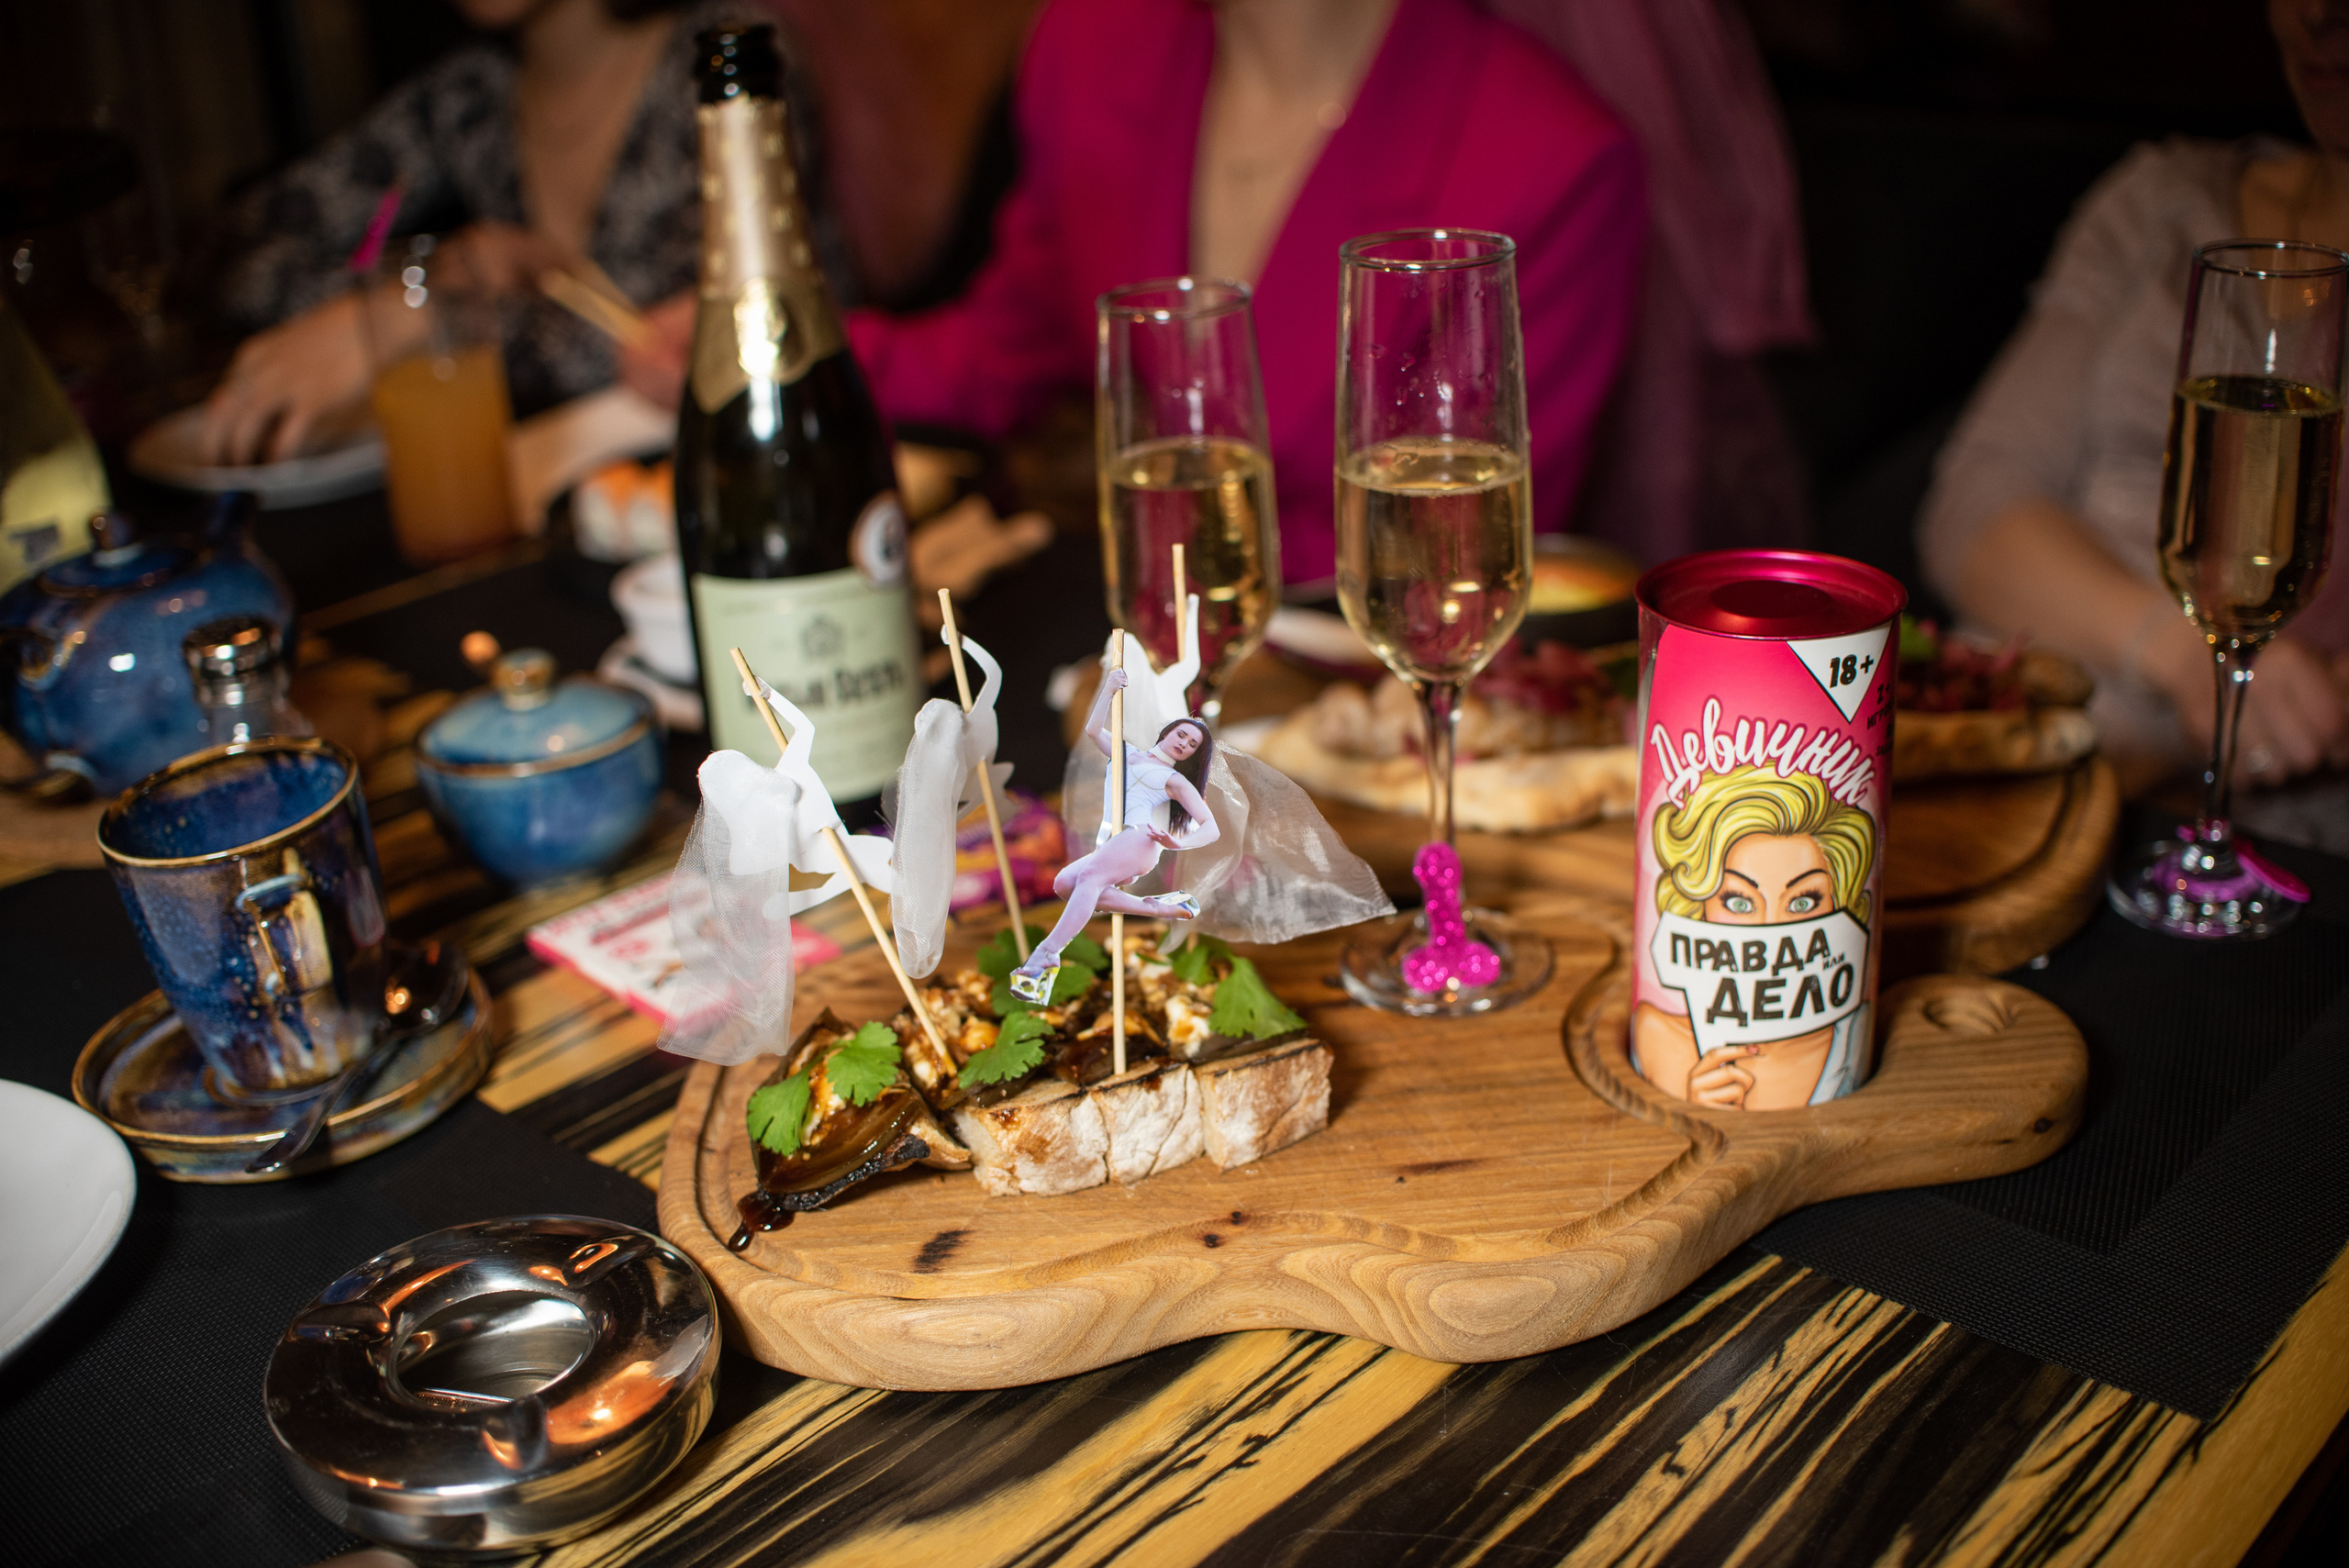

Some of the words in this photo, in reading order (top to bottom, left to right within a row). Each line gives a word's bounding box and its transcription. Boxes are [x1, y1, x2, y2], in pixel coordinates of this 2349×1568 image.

[1829, 654, 1875, 688] 18+
[1651, 697, 1875, 810] Девичник
[1670, 928, 1831, 976] ПРАВДА
[1705, 962, 1854, 1029] ДЕЛО
